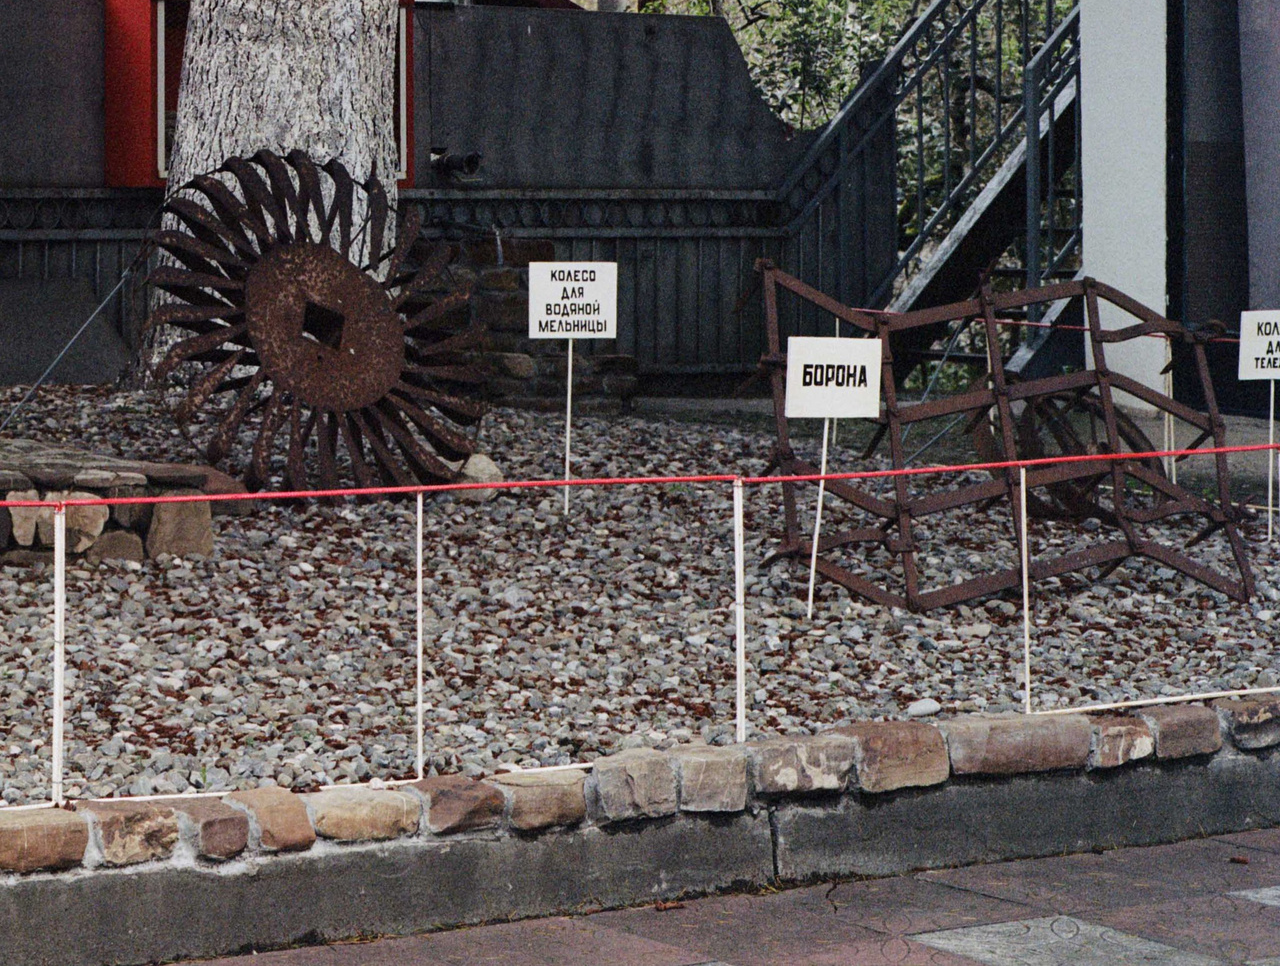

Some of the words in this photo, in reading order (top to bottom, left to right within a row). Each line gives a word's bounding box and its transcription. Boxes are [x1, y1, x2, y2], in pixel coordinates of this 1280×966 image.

[550, 270, 596, 282] КОЛЕСО
[561, 286, 584, 301] ДЛЯ
[545, 299, 600, 318] ВОДЯНОЙ
[538, 319, 607, 334] МЕЛЬНИЦЫ
[1254, 356, 1280, 369] ТЕЛЕ
[802, 363, 868, 388] БОРОНА
